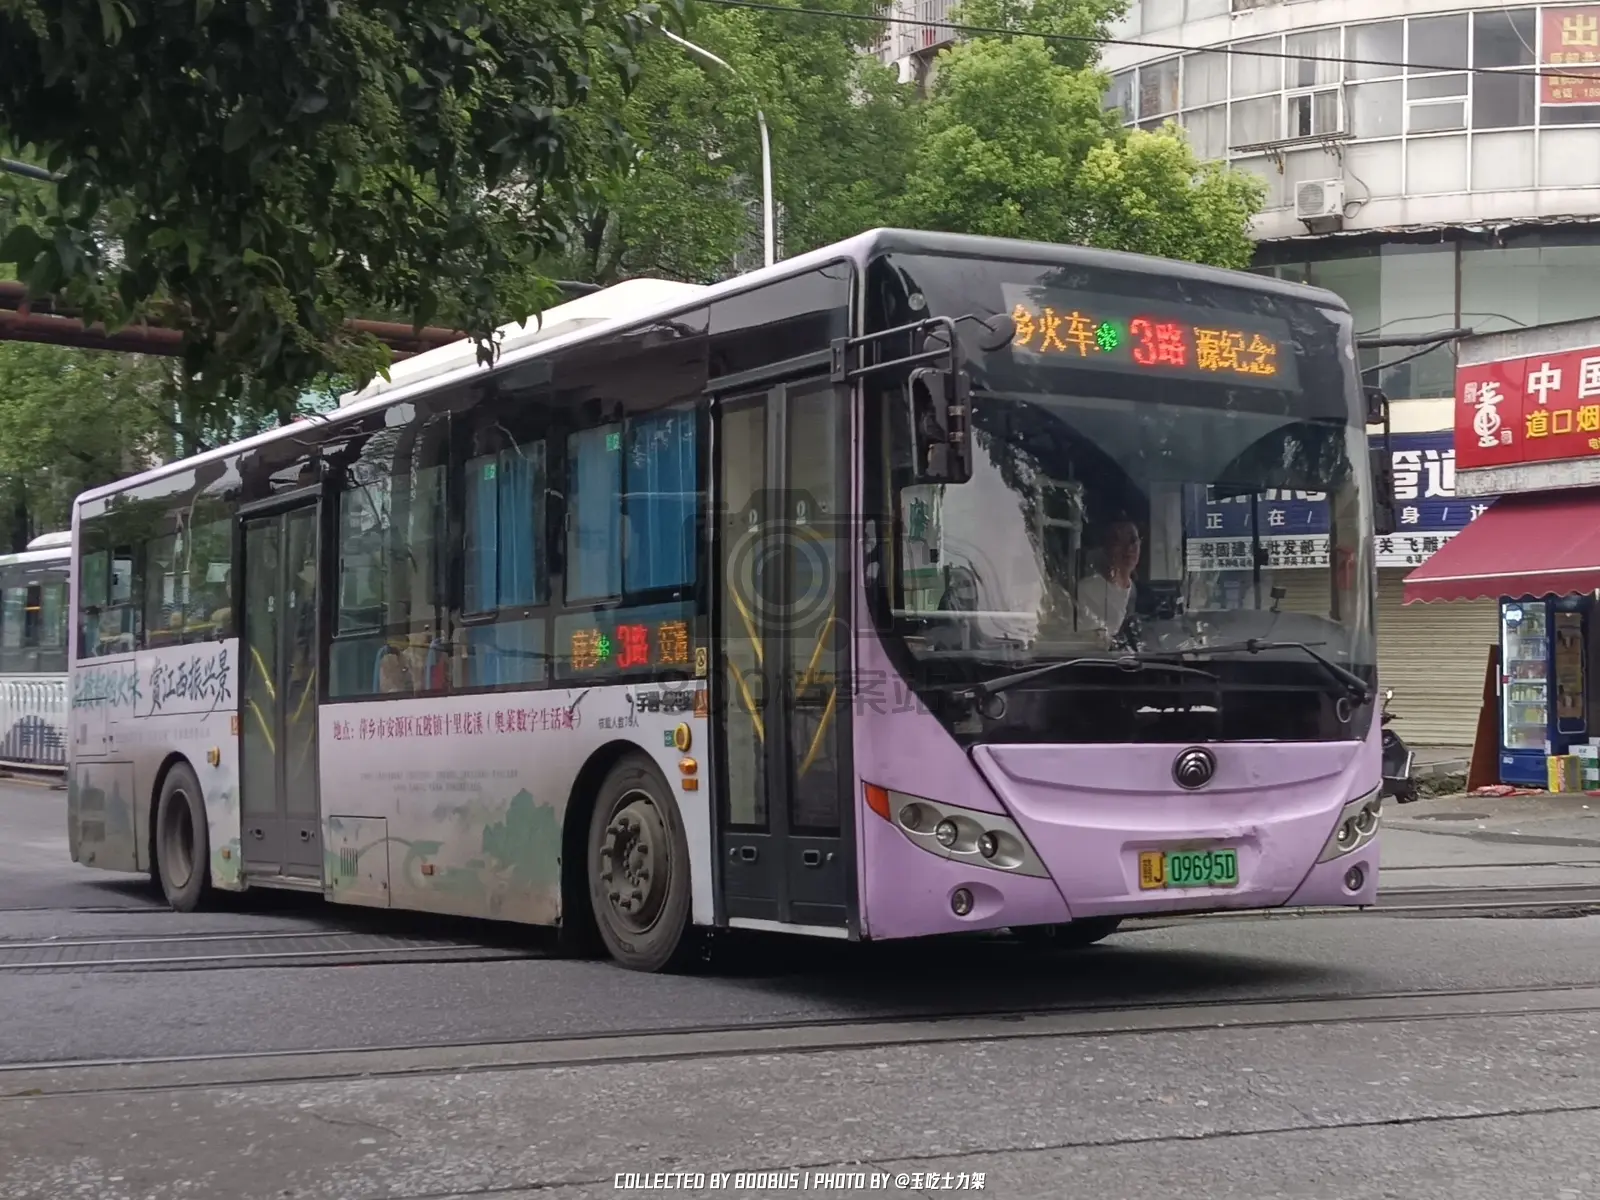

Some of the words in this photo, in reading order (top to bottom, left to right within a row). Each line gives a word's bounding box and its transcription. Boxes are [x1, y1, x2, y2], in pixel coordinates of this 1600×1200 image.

[1562, 14, 1598, 46] 出
[1267, 508, 1286, 527] 在
[1401, 506, 1420, 524] 身
